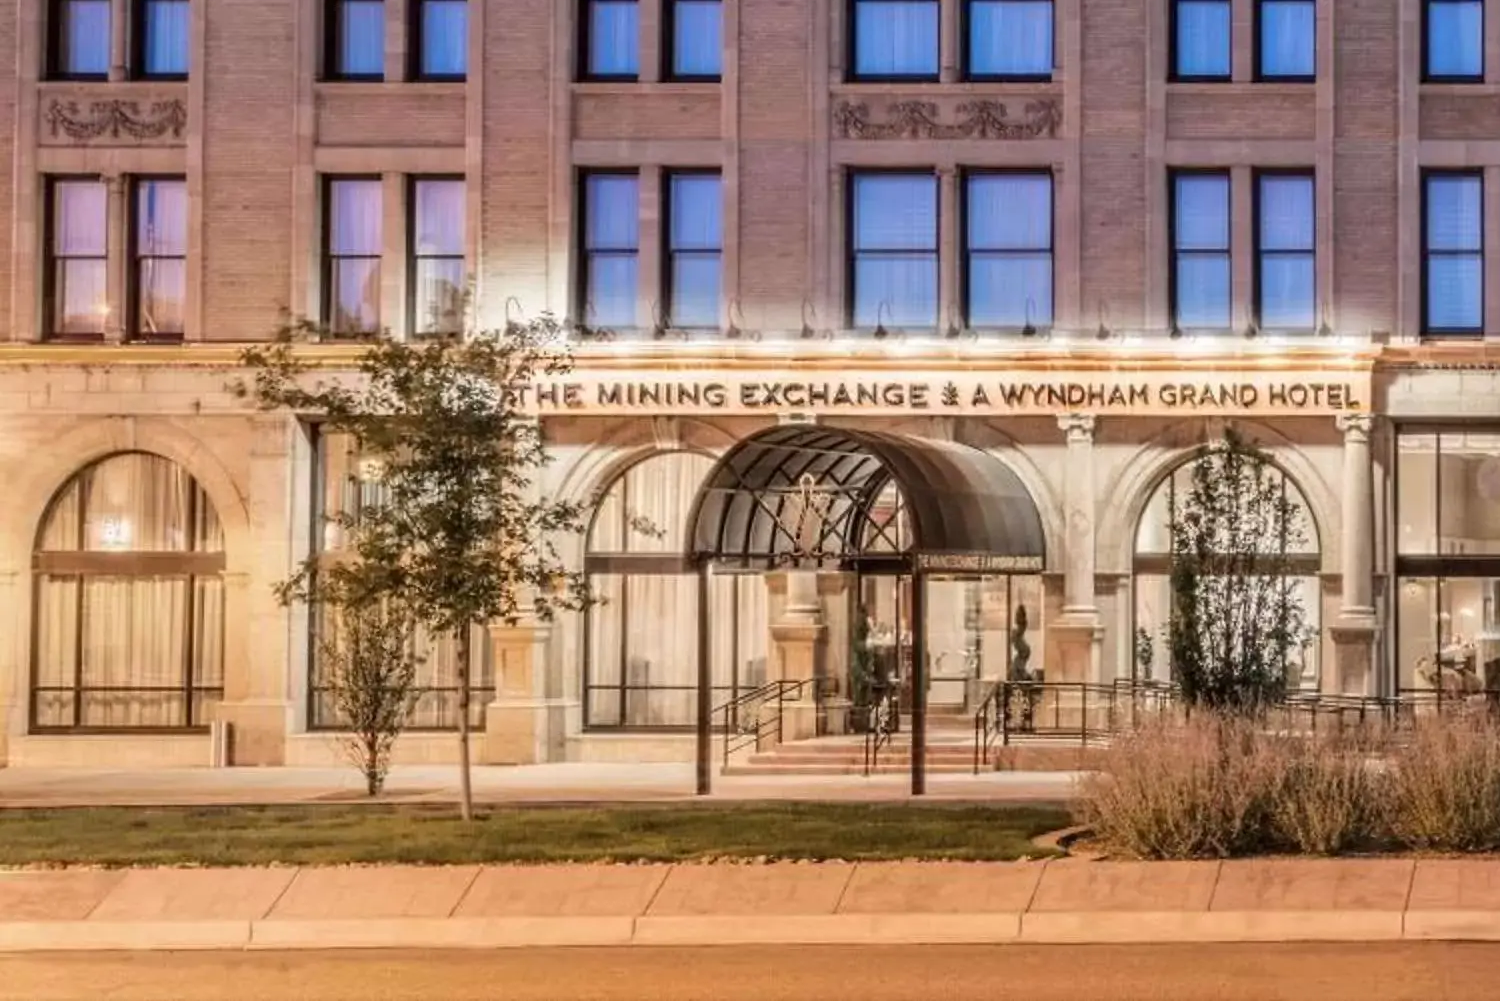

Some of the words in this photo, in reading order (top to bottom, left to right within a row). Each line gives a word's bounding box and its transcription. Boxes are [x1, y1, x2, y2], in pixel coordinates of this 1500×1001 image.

[509, 383, 584, 408] THE
[597, 383, 725, 407] MINING
[739, 383, 929, 407] EXCHANGE
[971, 384, 990, 407] A
[1000, 383, 1148, 407] WYNDHAM
[1158, 383, 1259, 407] GRAND
[1269, 383, 1360, 409] HOTEL
